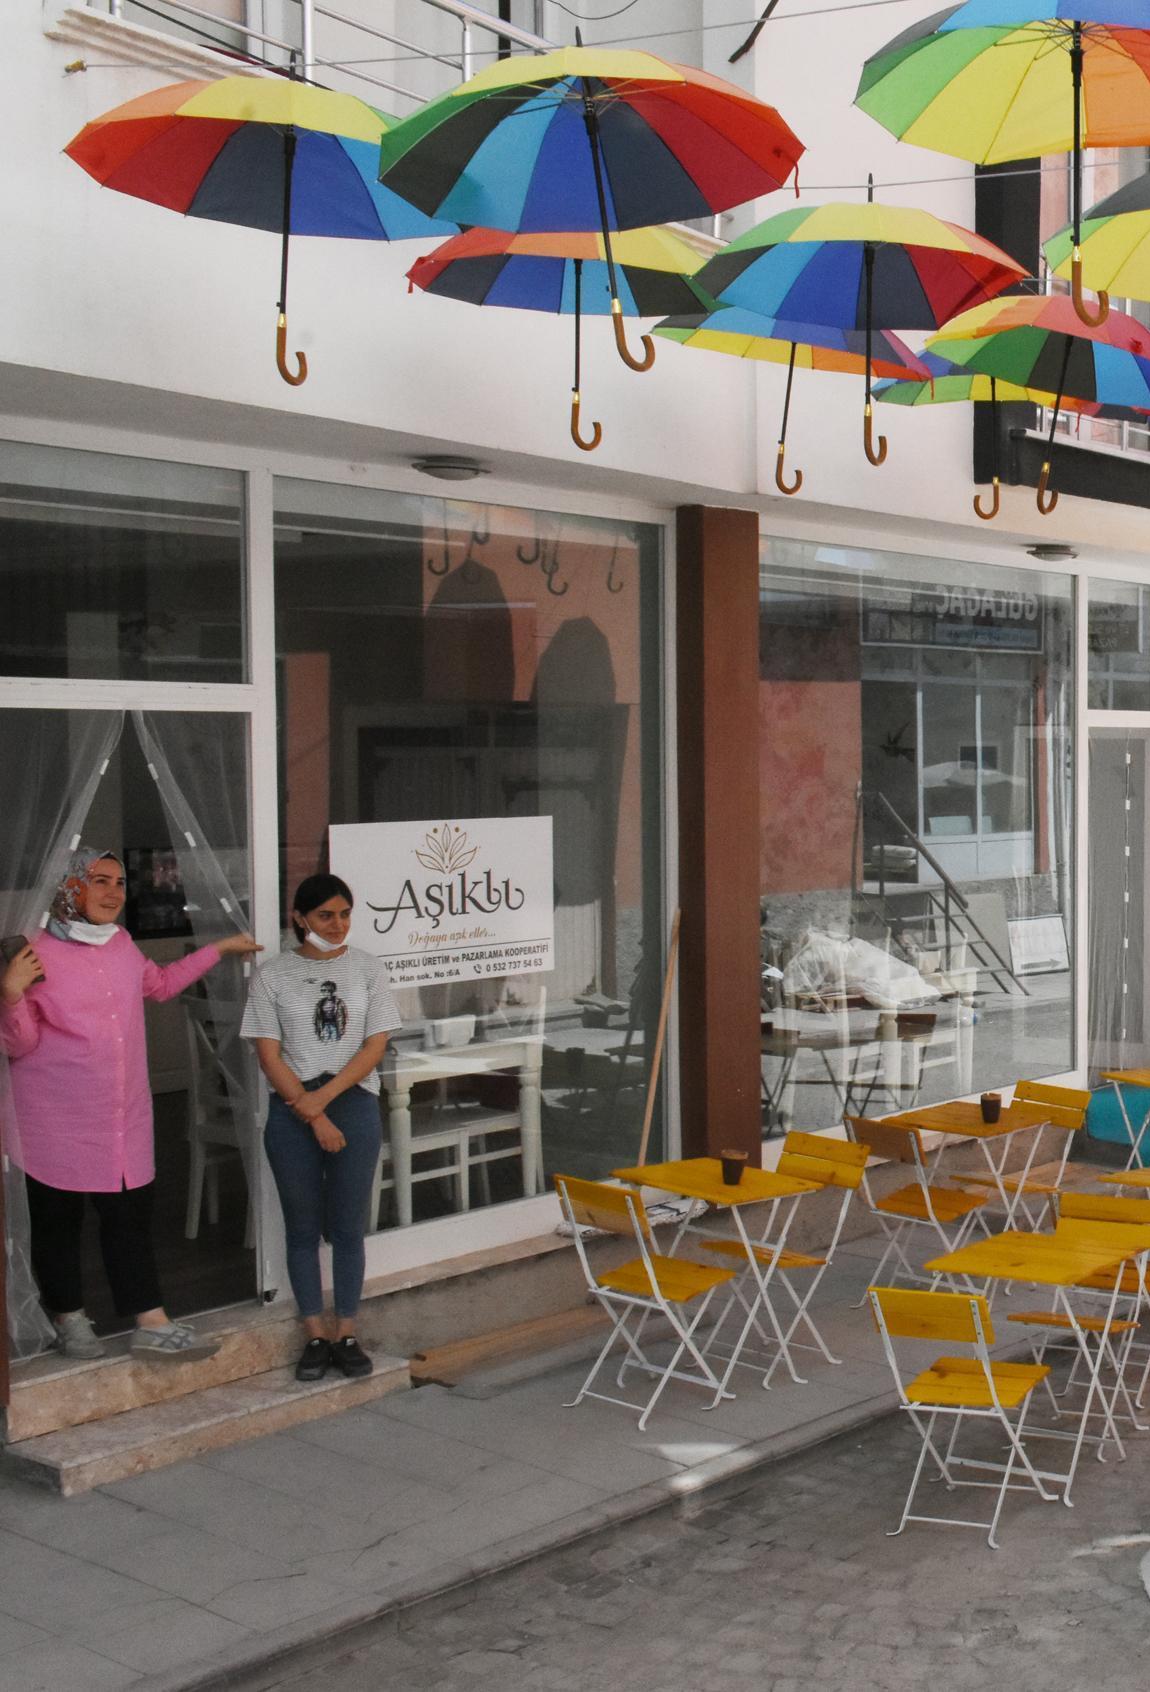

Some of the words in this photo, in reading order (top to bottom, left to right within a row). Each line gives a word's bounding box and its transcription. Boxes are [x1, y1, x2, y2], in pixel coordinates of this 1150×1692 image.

[395, 959, 421, 971] AŞIKLI
[422, 955, 451, 967] ÜRETİM
[451, 955, 460, 963] ve
[461, 949, 503, 962] PAZARLAMA
[493, 962, 506, 972] 532
[508, 960, 520, 969] 737
